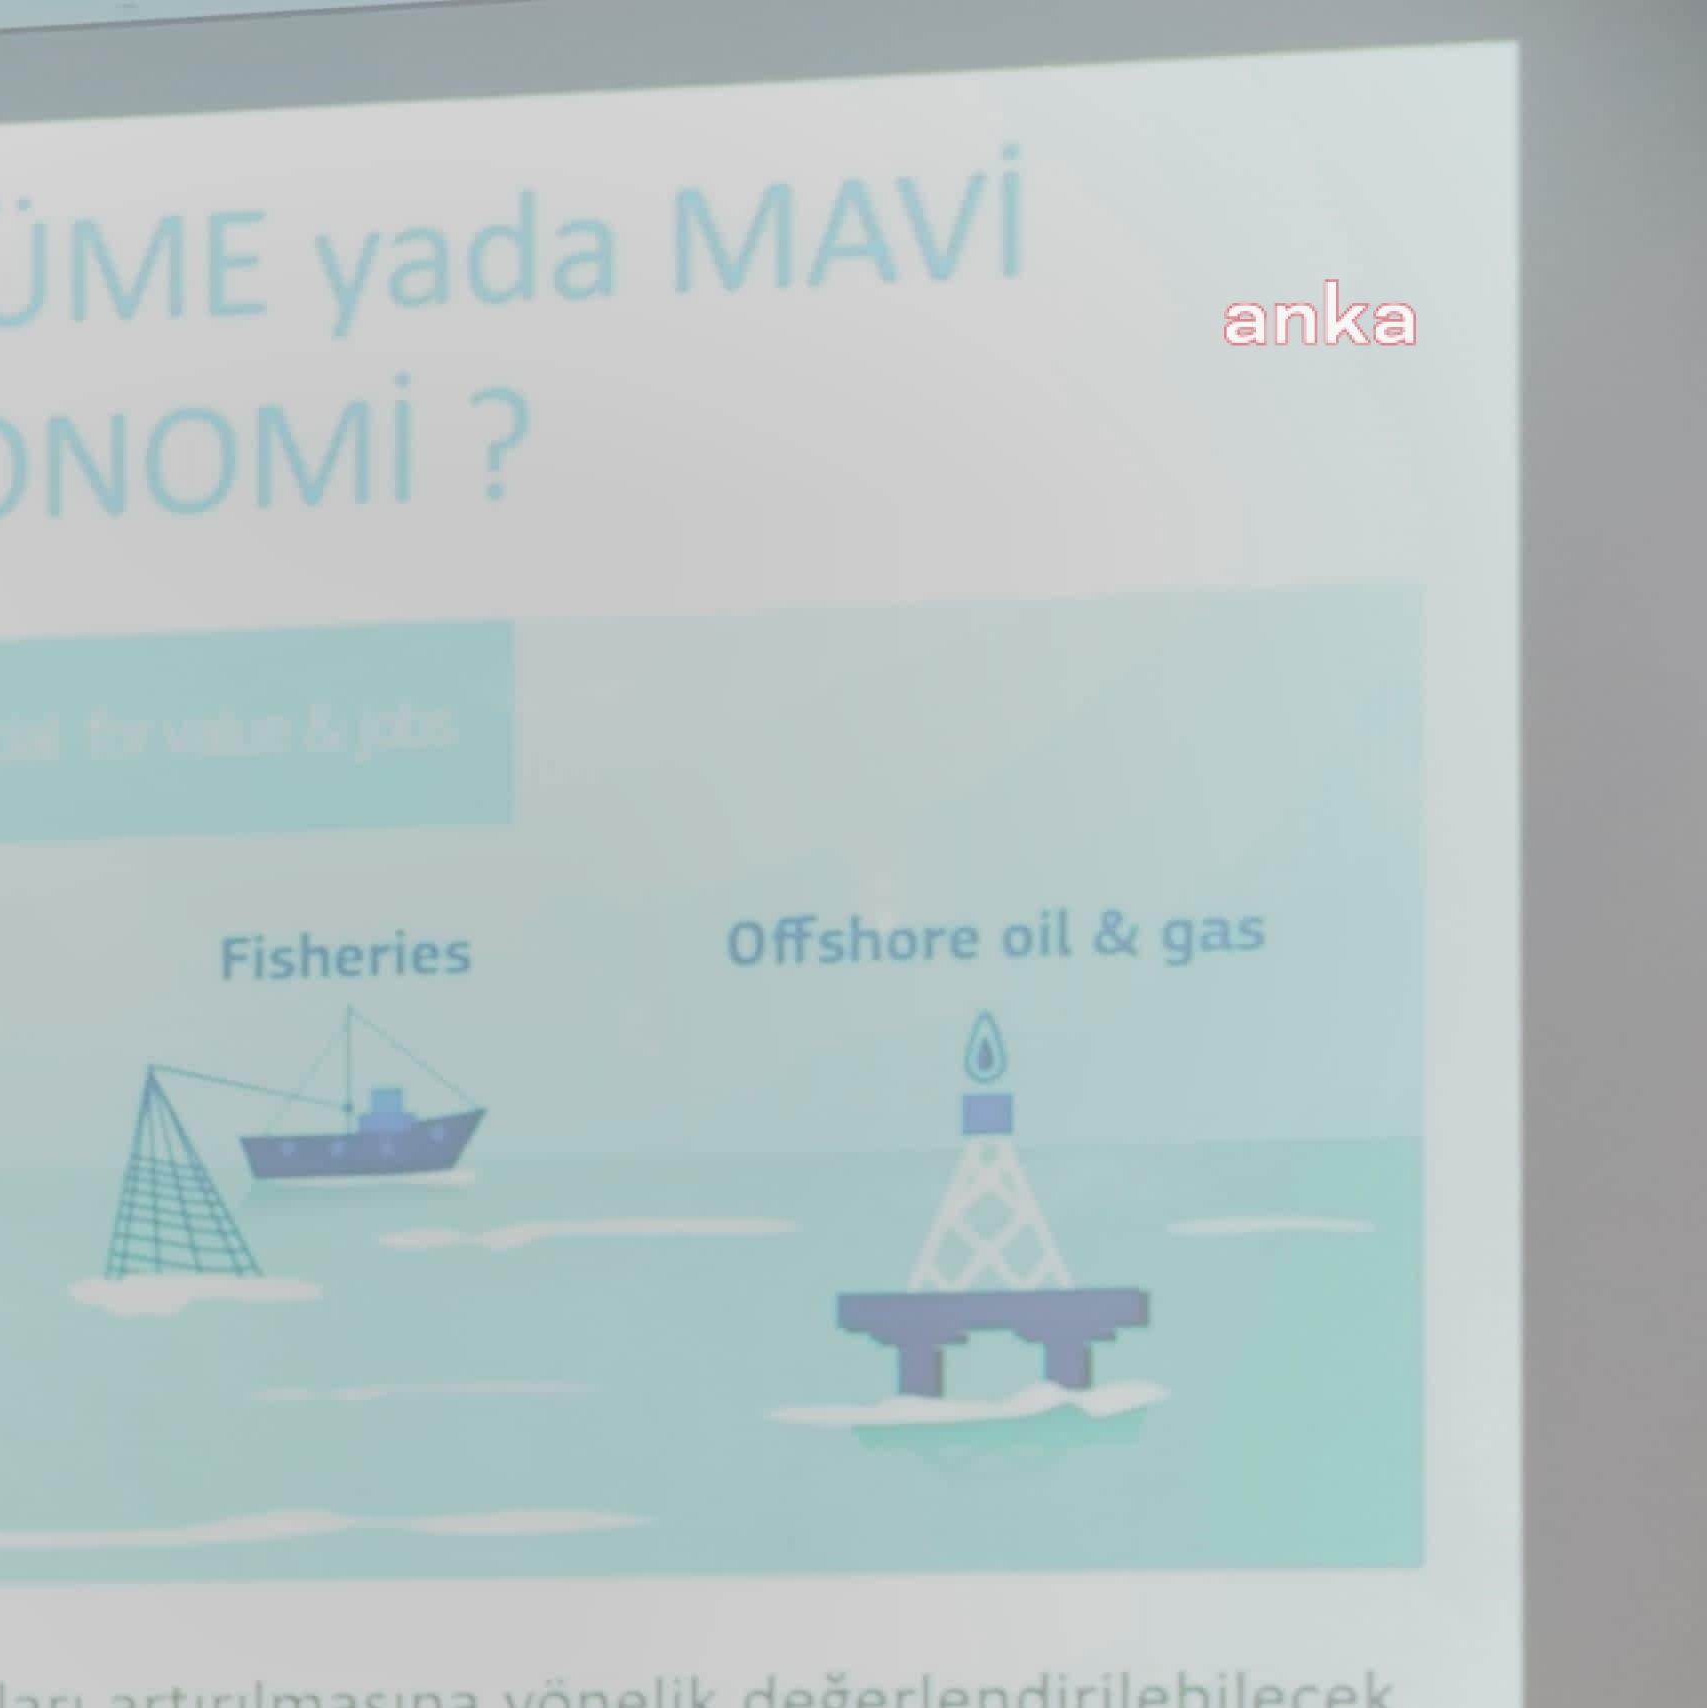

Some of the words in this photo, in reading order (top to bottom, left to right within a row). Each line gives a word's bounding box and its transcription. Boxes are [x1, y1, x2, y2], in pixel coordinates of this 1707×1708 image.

[314, 188, 617, 340] yada
[673, 143, 1022, 295] MAVİ
[470, 385, 531, 502] ?
[220, 929, 473, 981] Fisheries
[725, 913, 980, 968] Offshore
[1000, 907, 1073, 960] oil
[1091, 907, 1140, 958] &
[1160, 915, 1266, 968] gas
